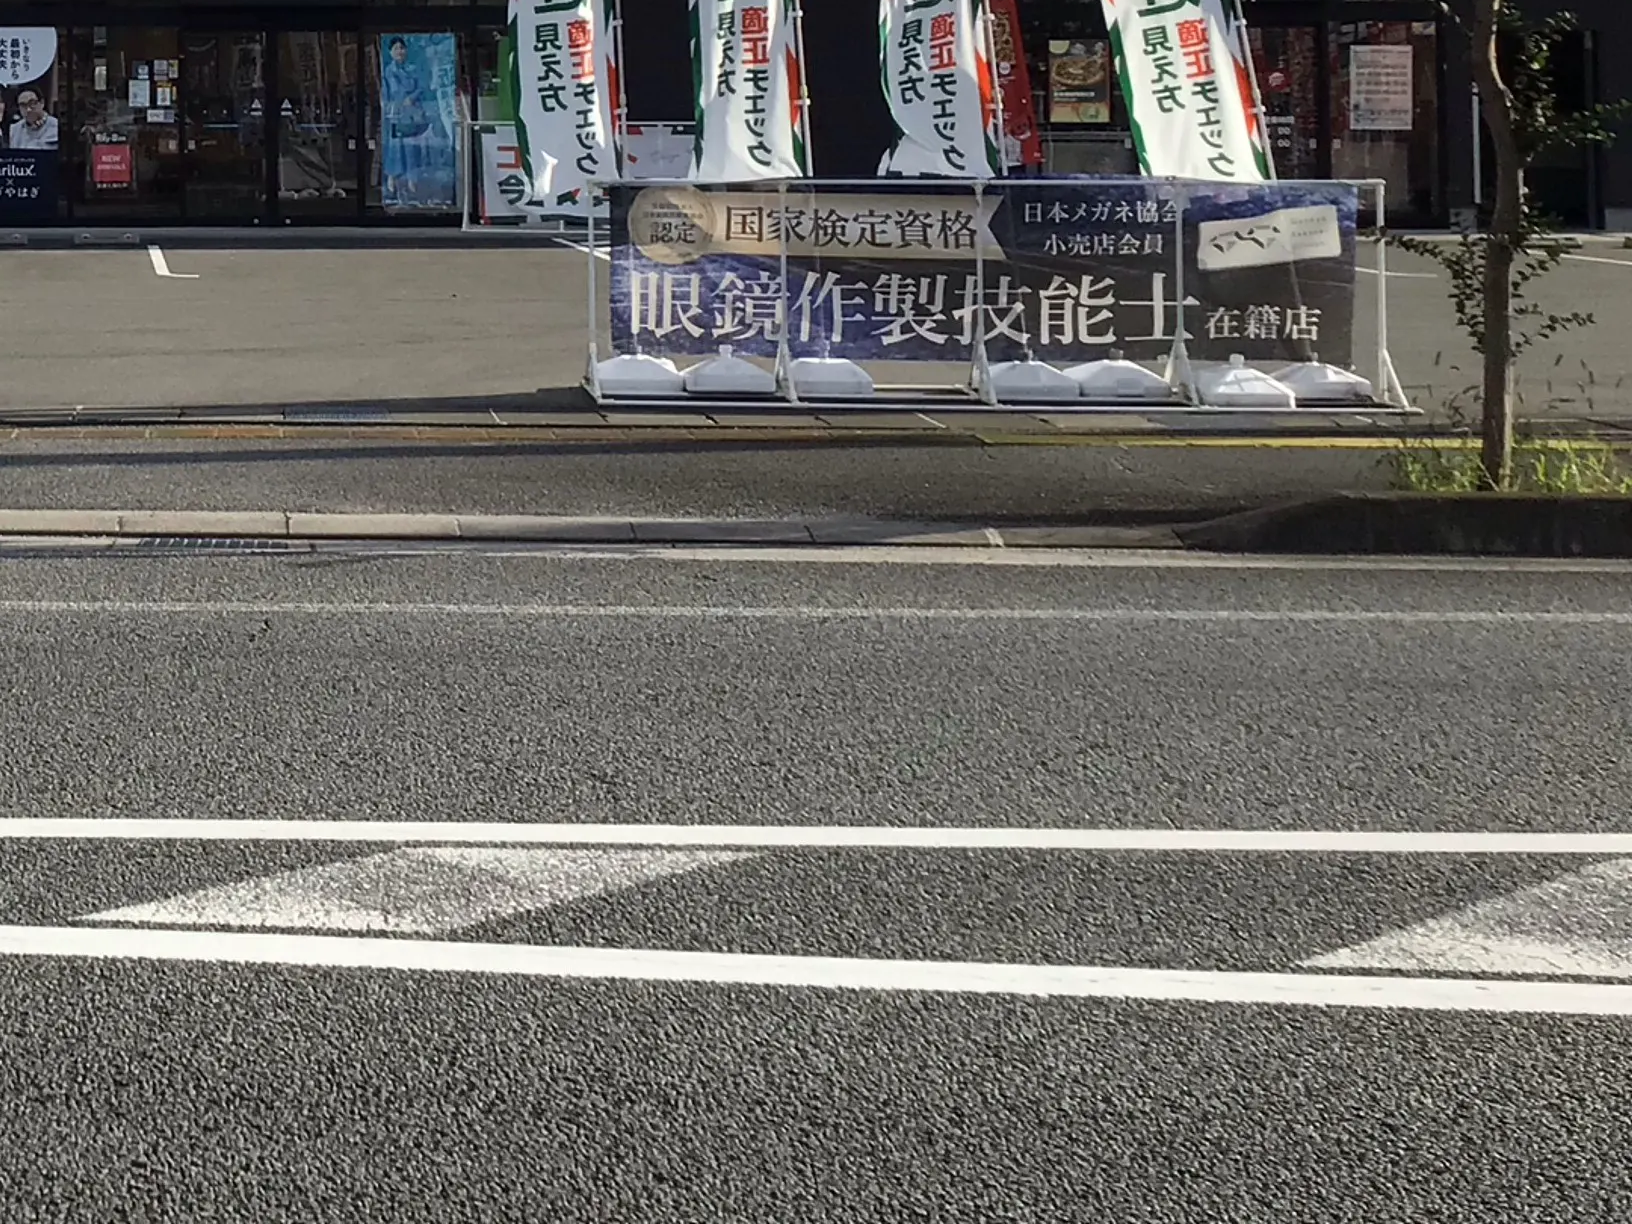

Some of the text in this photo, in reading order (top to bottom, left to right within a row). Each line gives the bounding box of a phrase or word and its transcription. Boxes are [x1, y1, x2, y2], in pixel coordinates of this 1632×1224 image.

[1024, 200, 1180, 224] 日本メガネ協会
[650, 221, 696, 244] 認定
[725, 204, 979, 250] 国家検定資格
[1044, 233, 1164, 257] 小売店会員
[631, 270, 1322, 346] 眼鏡作製技能士 在籍店
